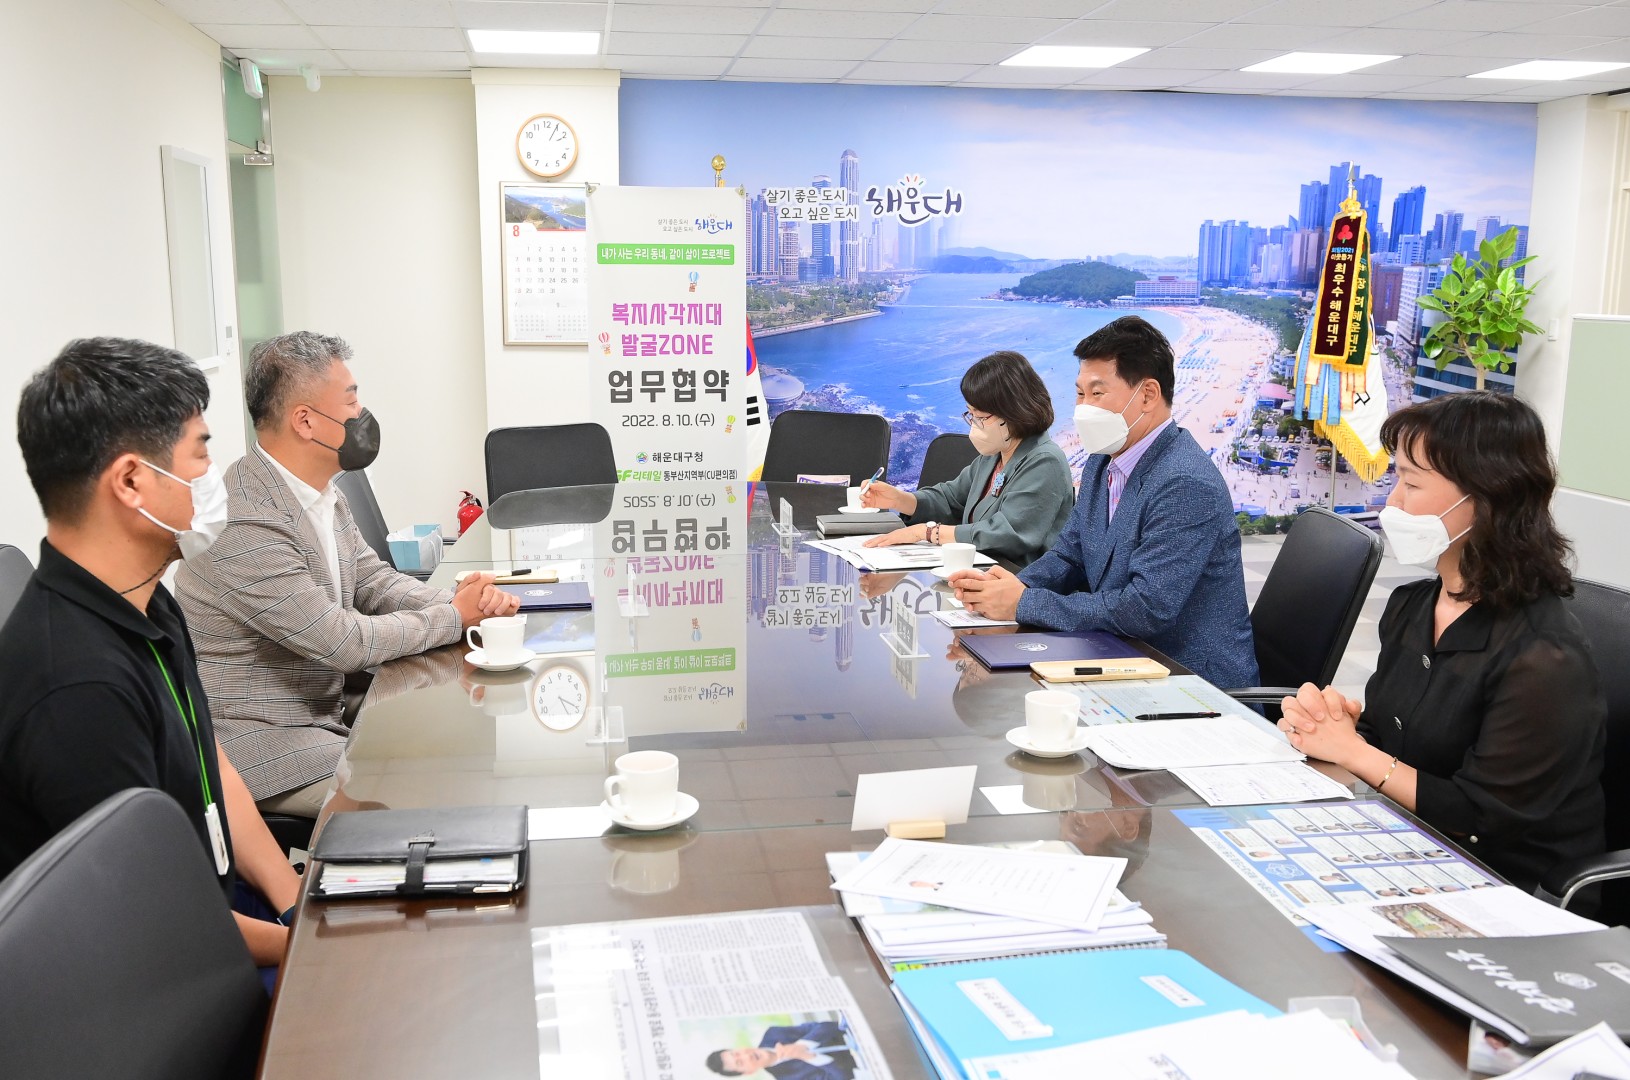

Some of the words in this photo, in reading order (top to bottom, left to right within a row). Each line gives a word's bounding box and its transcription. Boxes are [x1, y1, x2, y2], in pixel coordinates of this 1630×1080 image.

[766, 190, 790, 203] 살기
[795, 190, 818, 203] 좋은
[822, 190, 845, 202] 도시
[865, 187, 962, 224] 해운대
[780, 207, 803, 220] 오고
[807, 206, 830, 220] 싶은
[834, 206, 857, 220] 도시
[513, 225, 520, 237] 8
[602, 248, 616, 260] 내가
[618, 248, 632, 260] 사는
[634, 248, 649, 260] 우리
[650, 248, 667, 260] 동네,
[669, 248, 684, 260] 같이
[701, 249, 731, 260] 프로젝트
[1331, 263, 1346, 297] 최우수
[612, 303, 722, 326] 복지사각지대
[1326, 300, 1342, 346] 해운대구
[622, 334, 713, 356] 발굴ZONE
[608, 368, 729, 403] 업무협약
[622, 415, 658, 427] 2022.
[652, 452, 703, 462] 해운대구청
